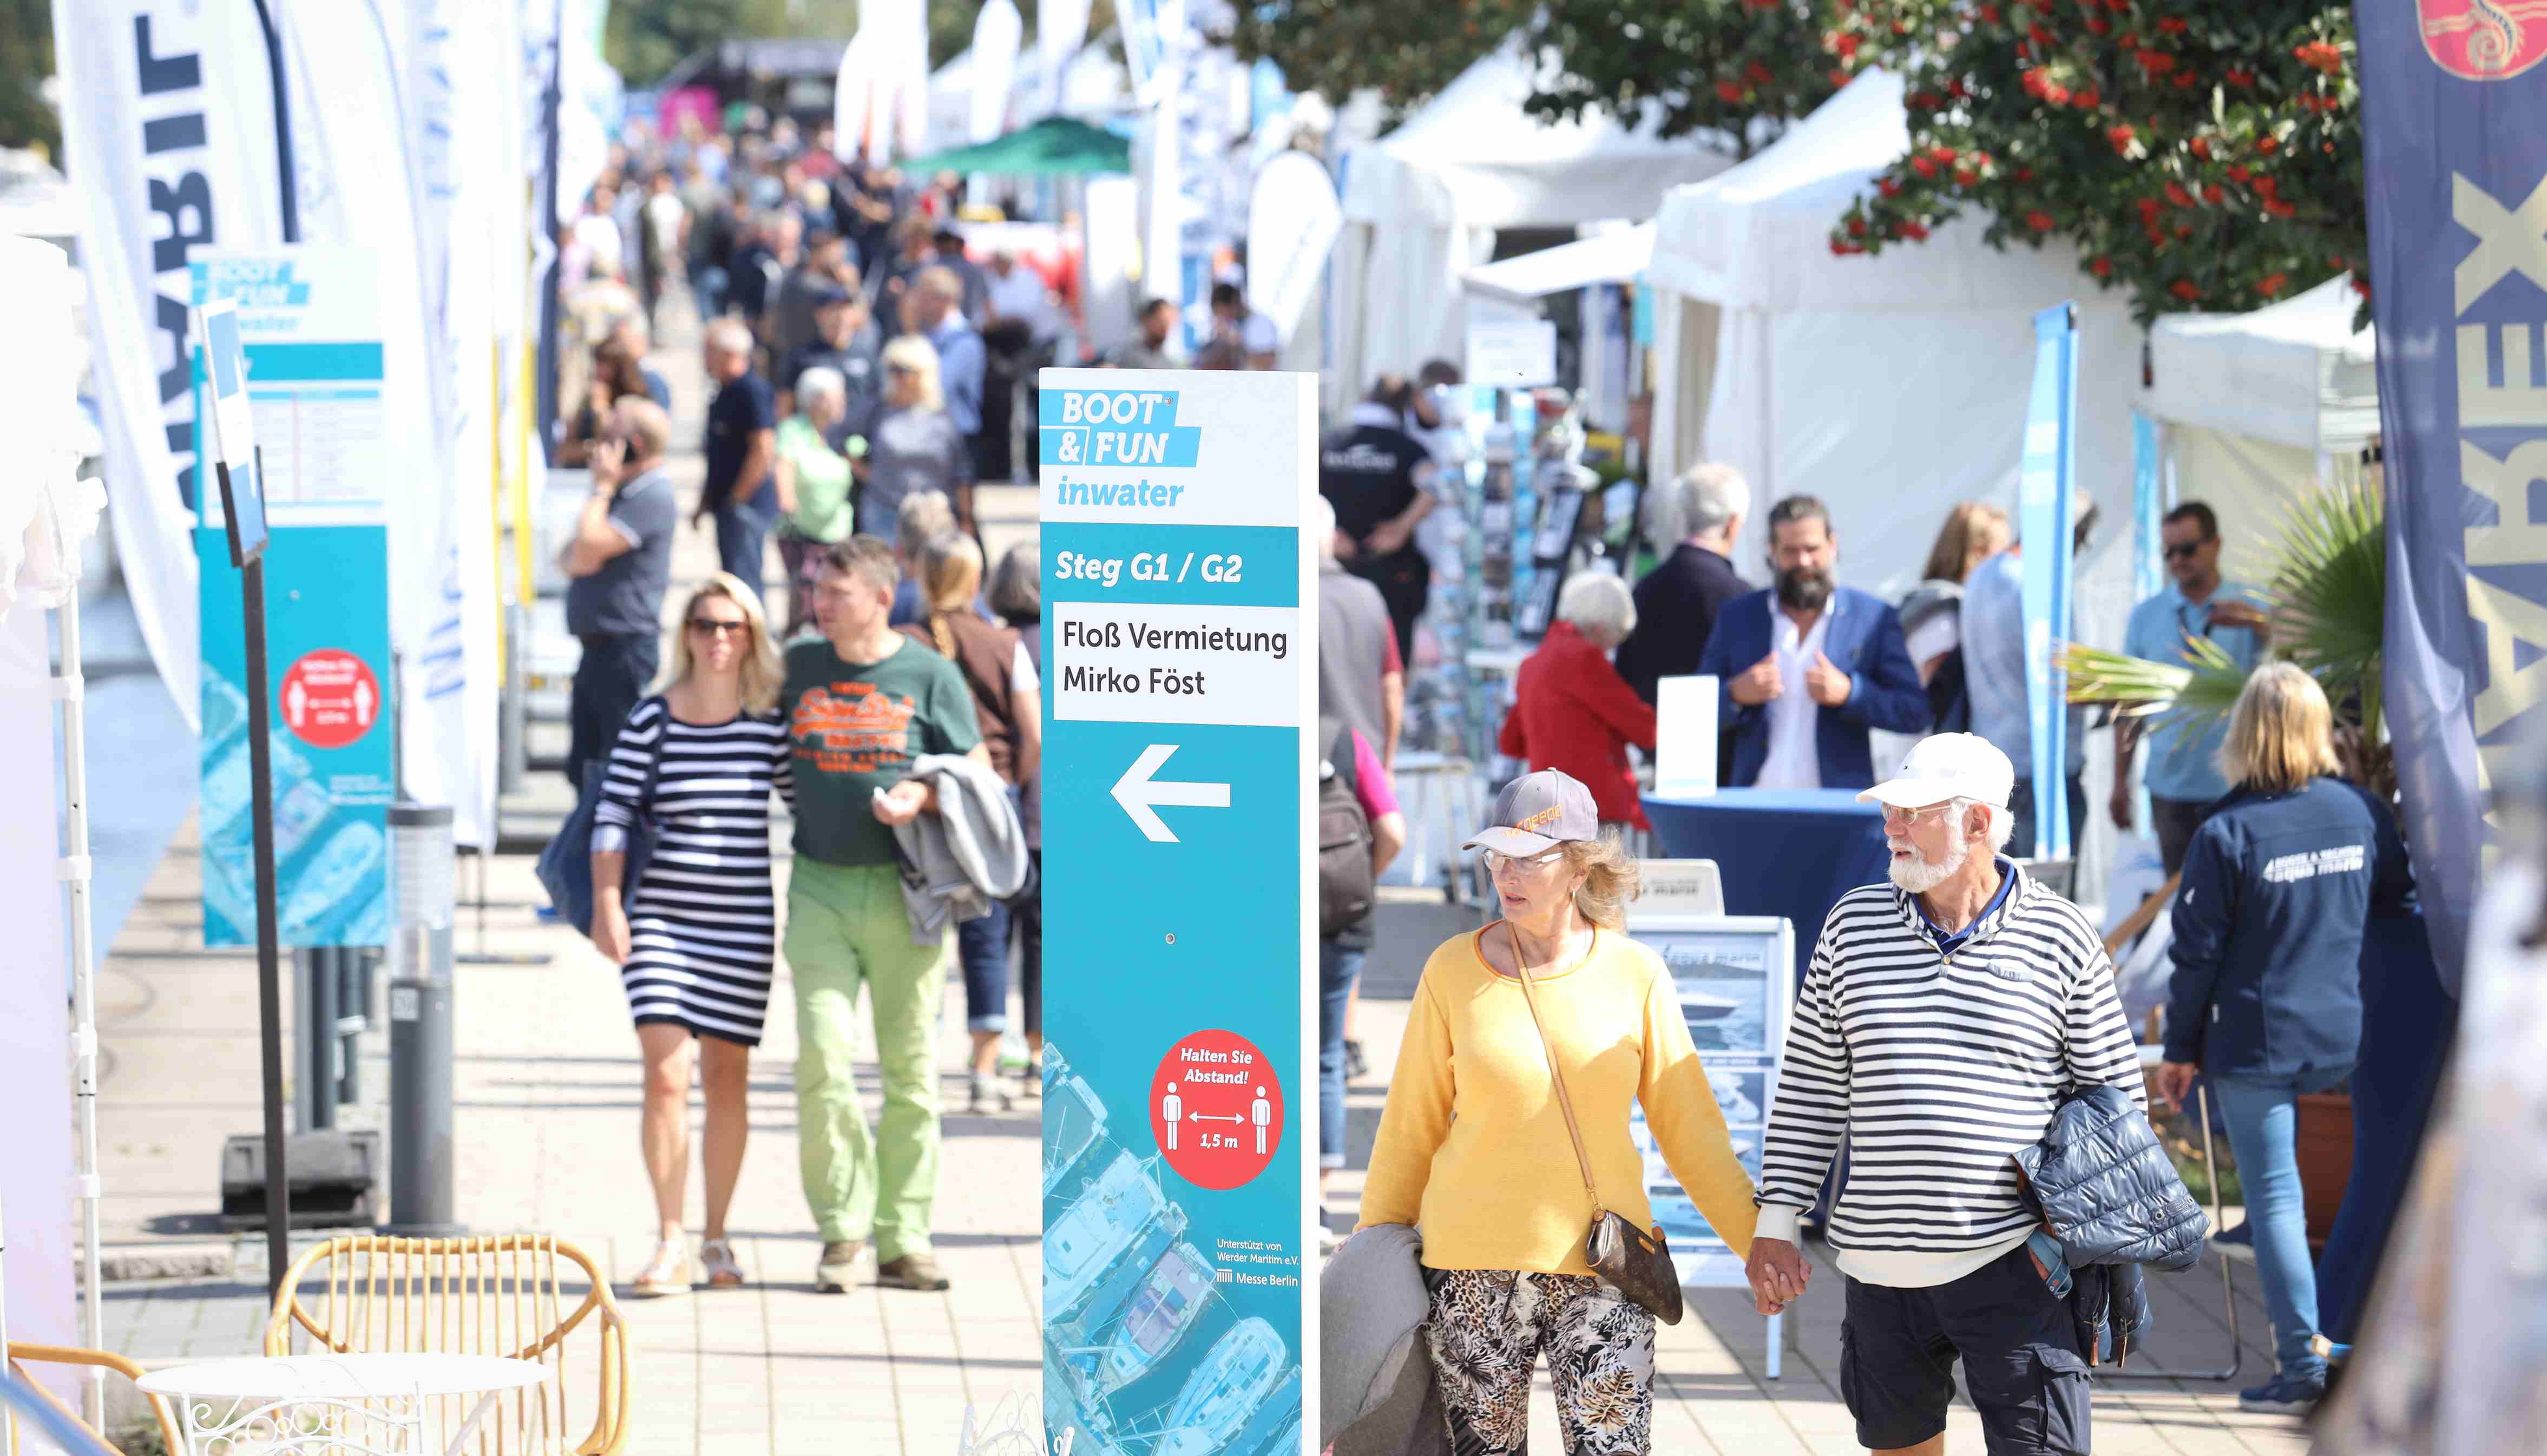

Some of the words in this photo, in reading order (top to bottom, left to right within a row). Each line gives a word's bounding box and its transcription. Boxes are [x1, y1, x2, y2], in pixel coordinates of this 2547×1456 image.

[1062, 392, 1163, 425] BOOT
[1058, 431, 1081, 463] &
[1094, 431, 1170, 464] FUN
[1058, 475, 1184, 507] inwater
[1055, 551, 1123, 588] Steg
[1131, 552, 1170, 582] G1
[1177, 552, 1195, 583] /
[1200, 554, 1243, 583] G2
[1064, 621, 1121, 648] Floß
[1128, 622, 1287, 660] Vermietung
[1064, 666, 1140, 693] Mirko
[1150, 668, 1205, 695] Föst
[1180, 1047, 1227, 1063] Halten
[1231, 1050, 1253, 1064] Sie
[1184, 1068, 1249, 1085] Abstand!
[1200, 1133, 1222, 1149] 1,5
[1224, 1137, 1238, 1148] m
[1217, 1238, 1264, 1250] Unterstützt
[1265, 1243, 1282, 1251] von
[1217, 1251, 1248, 1262] Werder
[1250, 1254, 1283, 1264] Maritim
[1284, 1255, 1299, 1266] e.V.
[1236, 1272, 1268, 1285] Messe
[1269, 1274, 1298, 1287] Berlin
